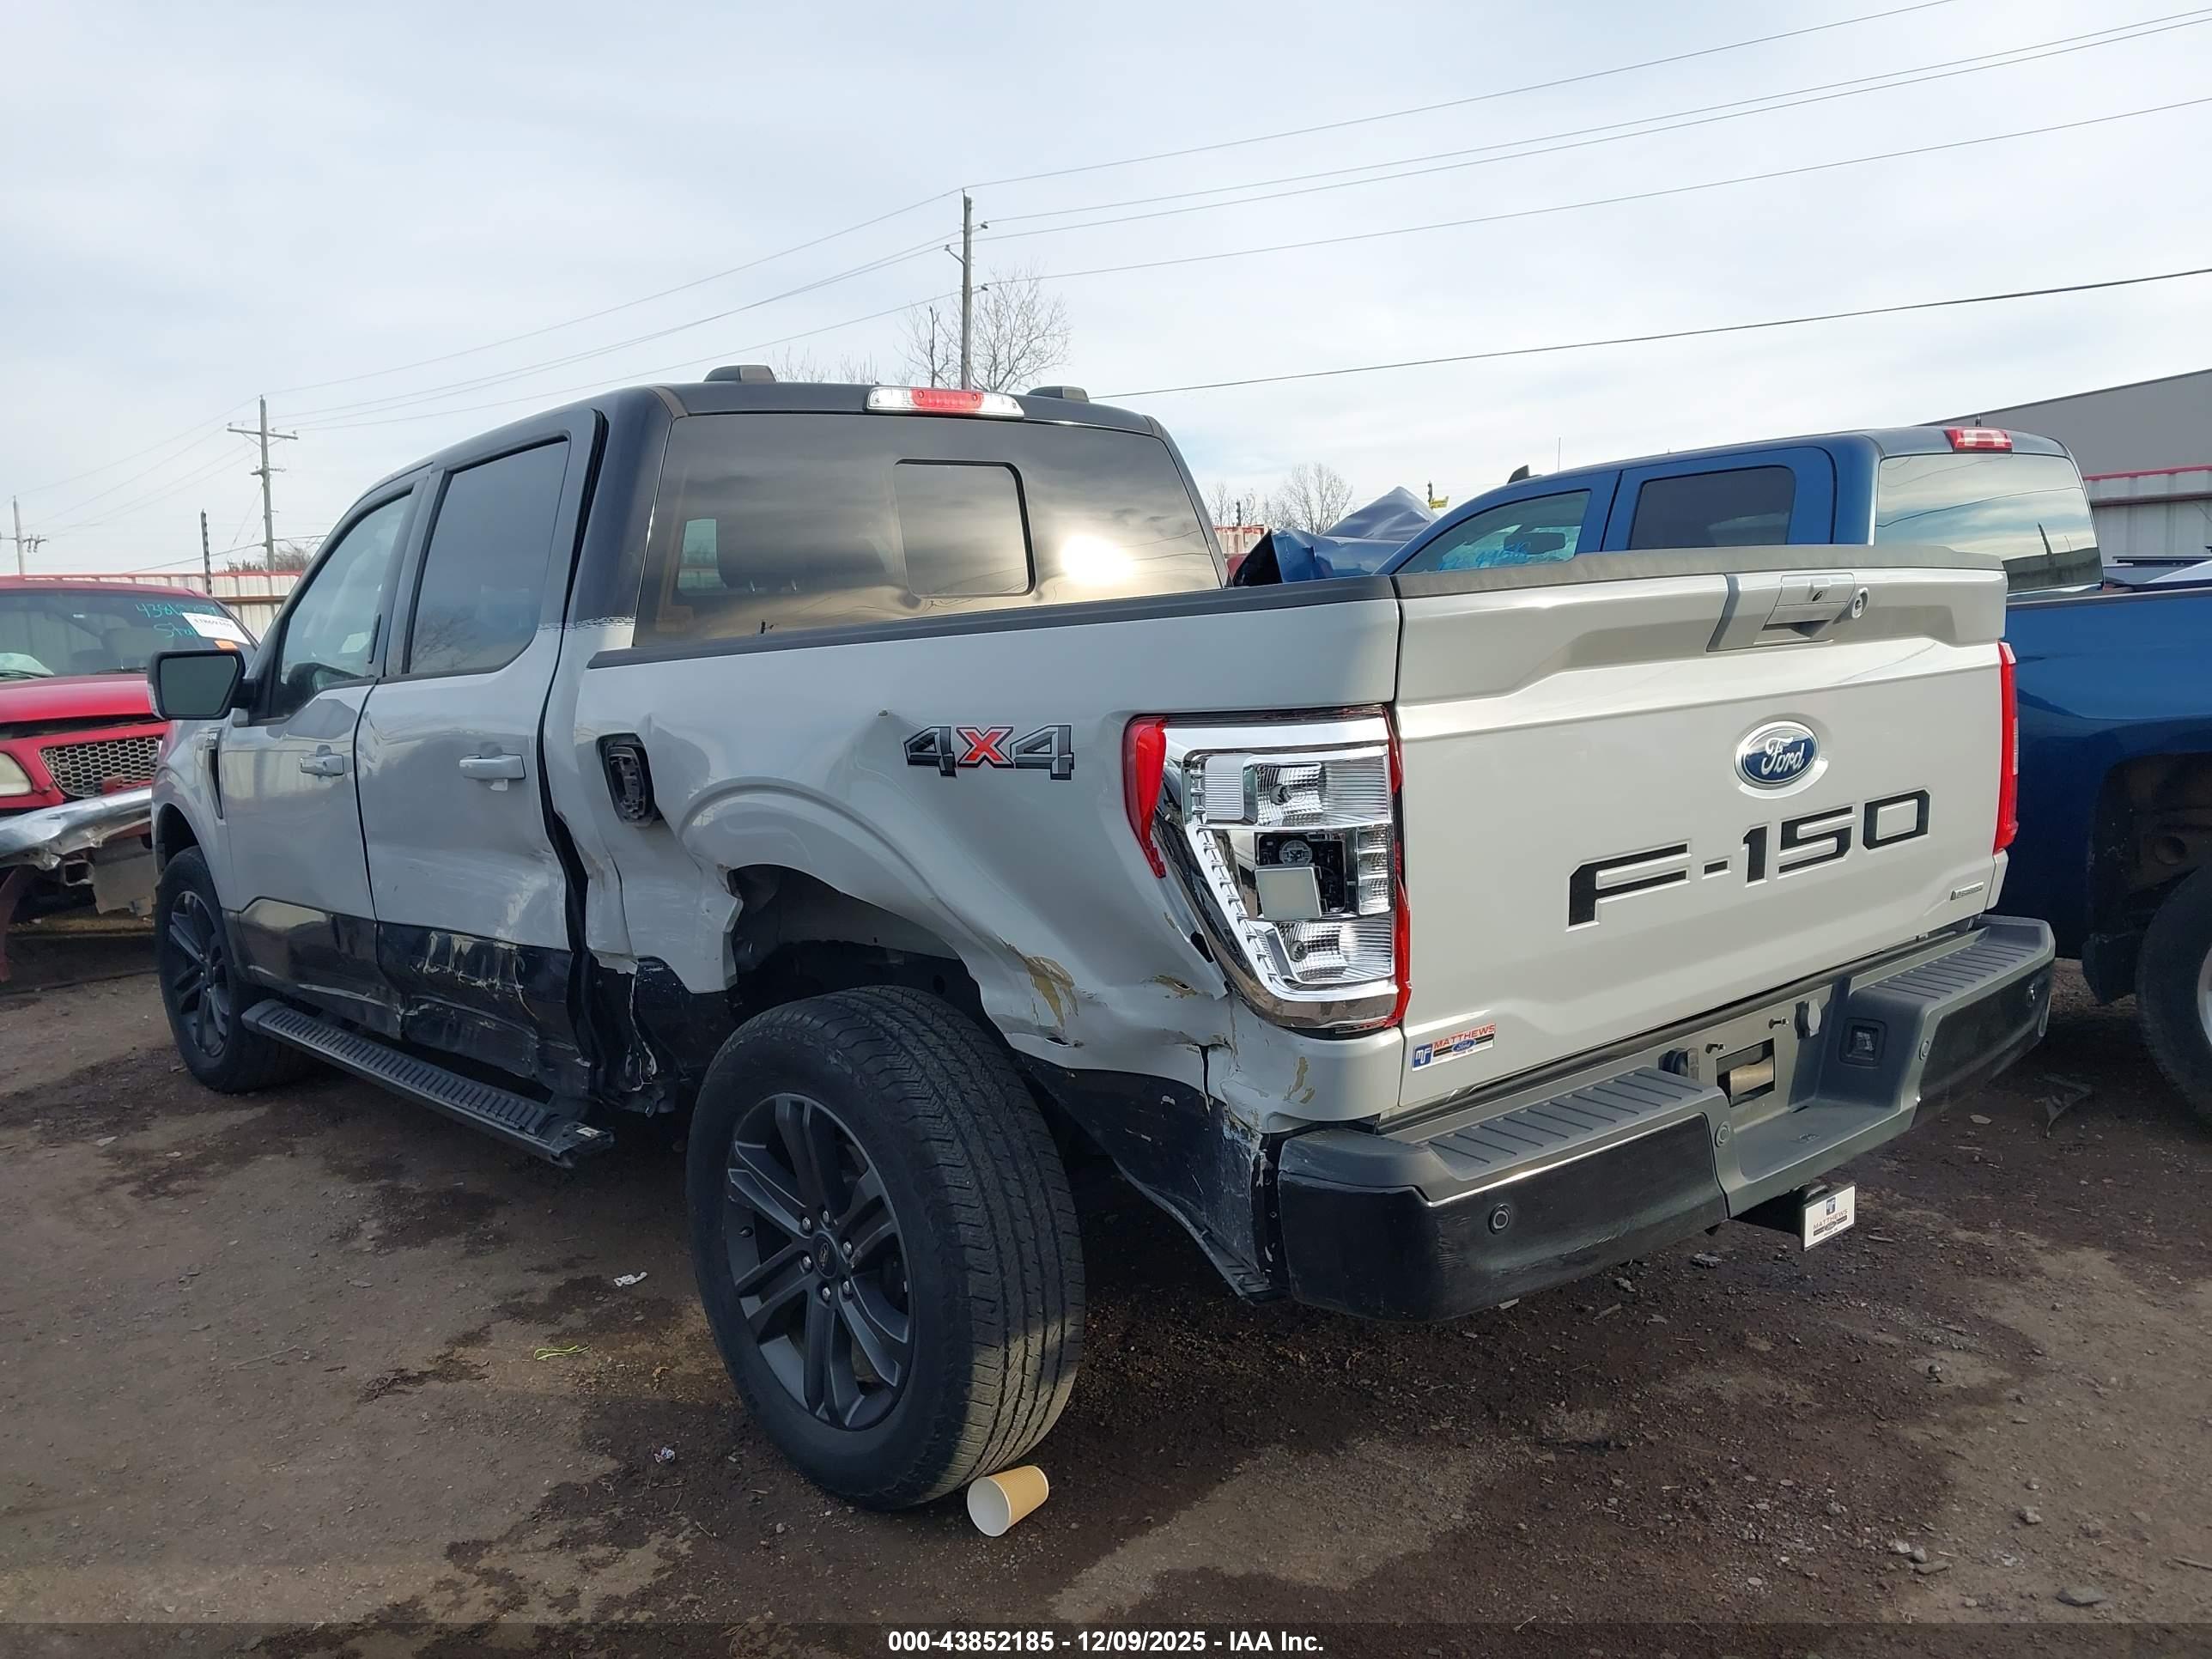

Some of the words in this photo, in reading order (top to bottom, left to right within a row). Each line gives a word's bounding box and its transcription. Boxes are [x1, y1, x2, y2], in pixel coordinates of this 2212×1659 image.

[1760, 737, 1807, 775] Ford
[1567, 788, 1930, 929] F-150
[1433, 1024, 1496, 1048] MATTHEWS
[1813, 1208, 1849, 1230] MATTHEWS
